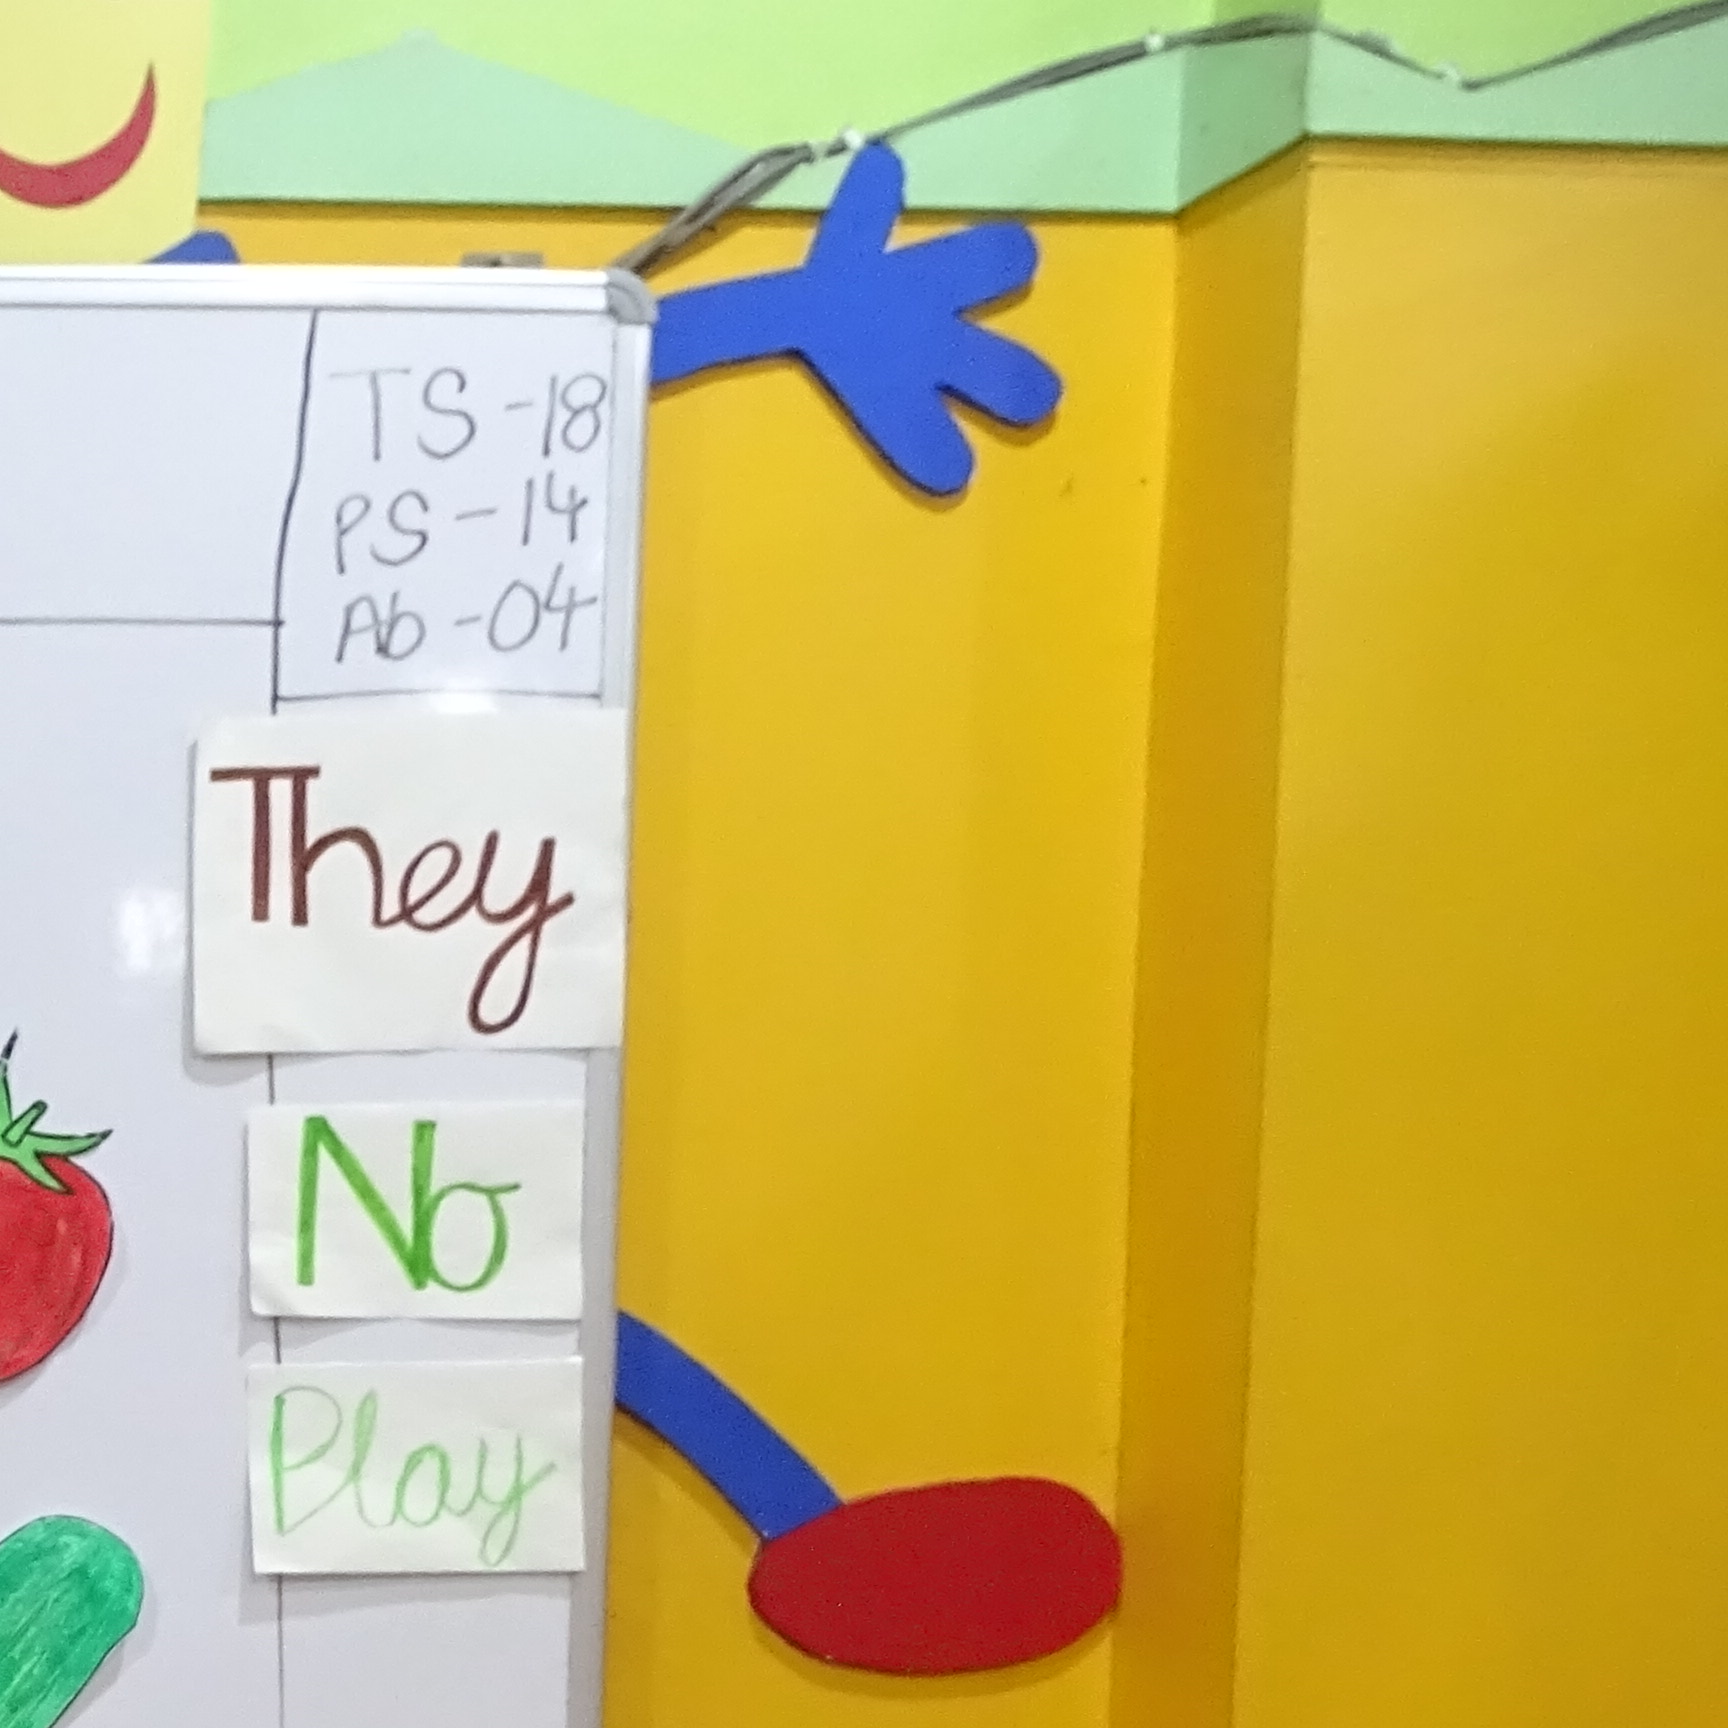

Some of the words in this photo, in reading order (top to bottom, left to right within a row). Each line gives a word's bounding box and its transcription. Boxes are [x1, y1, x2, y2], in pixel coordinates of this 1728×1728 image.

[329, 366, 478, 462] TS
[334, 489, 430, 575] PS
[208, 765, 575, 1035] They
[295, 1114, 523, 1293] No
[268, 1384, 558, 1568] Play
